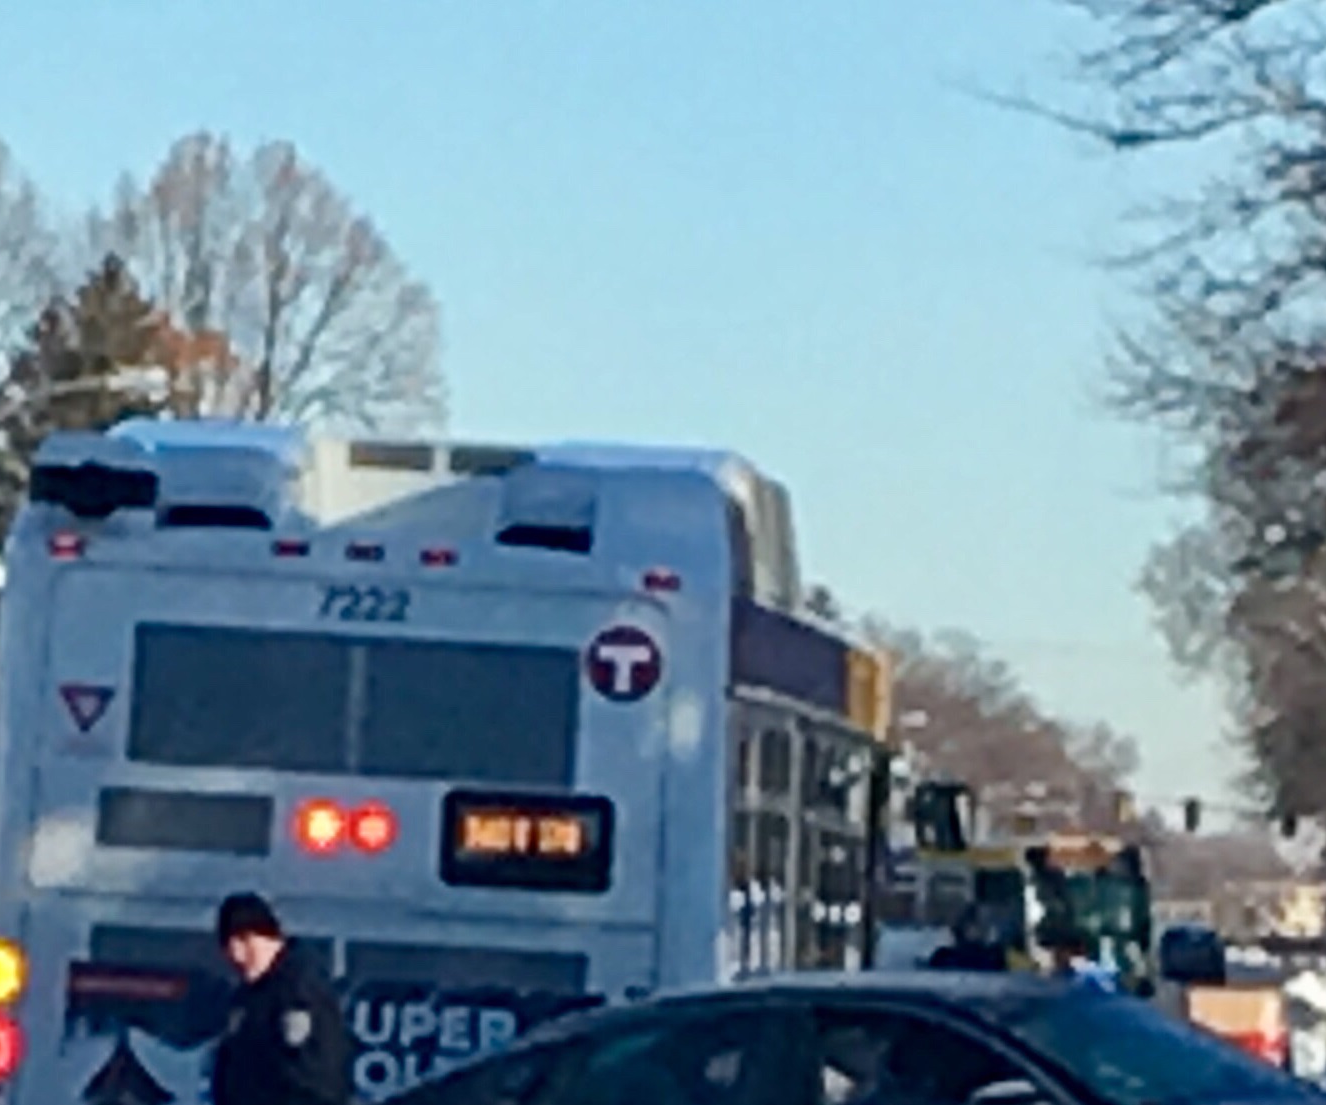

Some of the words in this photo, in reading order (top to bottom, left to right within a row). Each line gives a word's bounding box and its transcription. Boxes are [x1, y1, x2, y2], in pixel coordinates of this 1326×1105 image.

[317, 584, 412, 622] 7222
[598, 645, 651, 693] T
[353, 1000, 517, 1053] UPER
